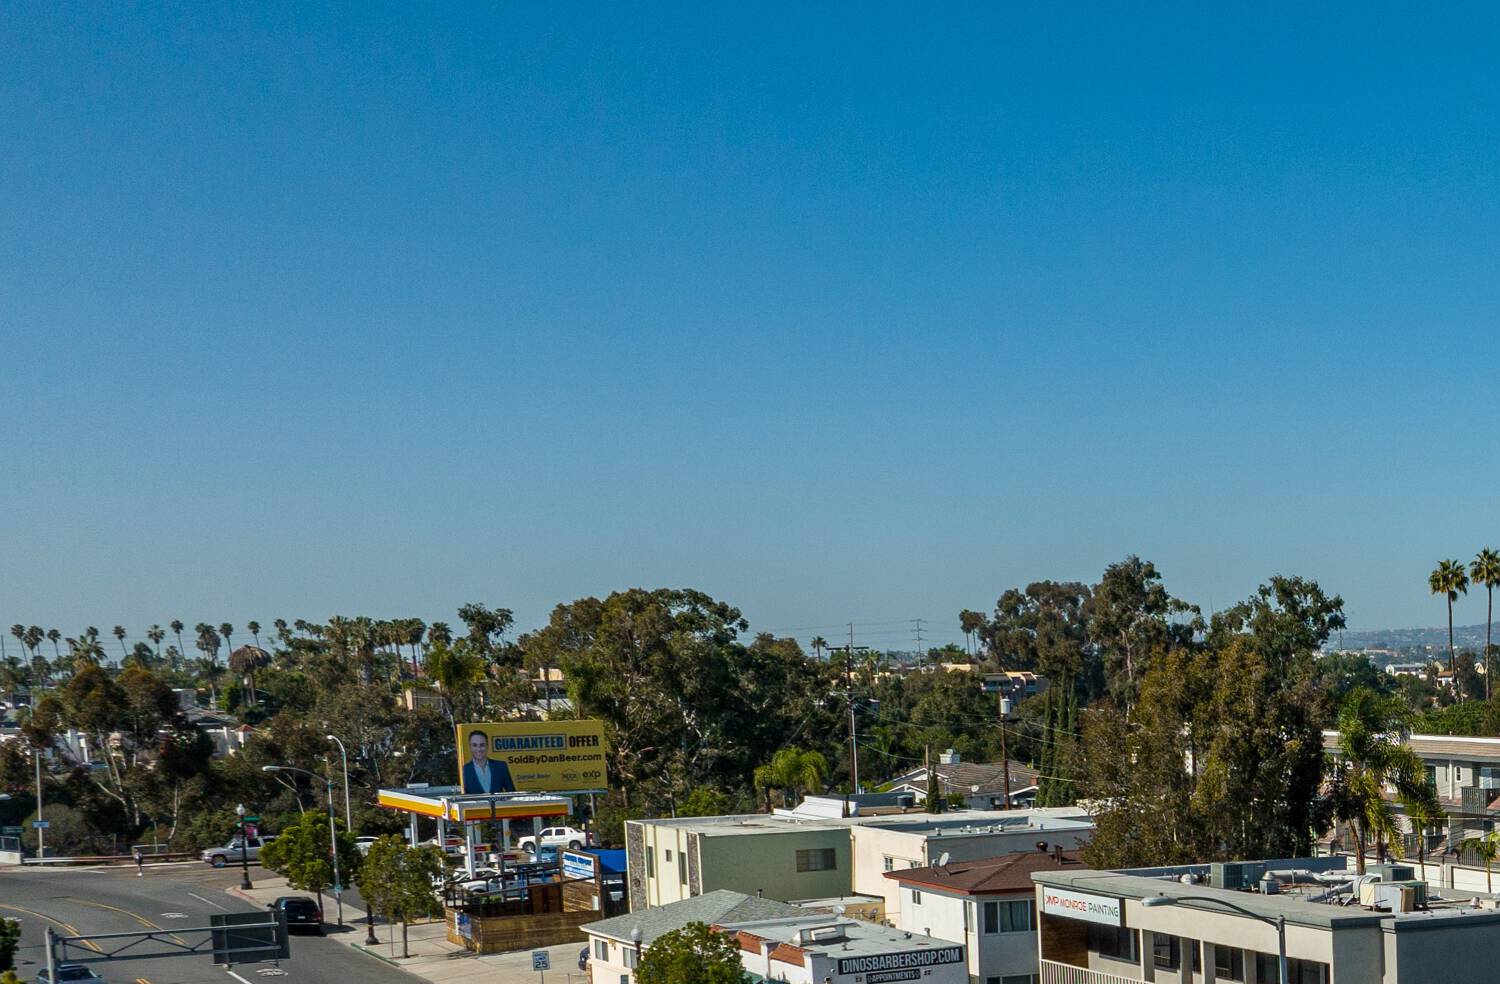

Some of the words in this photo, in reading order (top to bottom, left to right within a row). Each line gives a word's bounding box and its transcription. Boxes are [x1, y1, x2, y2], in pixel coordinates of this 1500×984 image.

[495, 736, 564, 750] GUARANTEED
[569, 735, 599, 747] OFFER
[508, 754, 602, 765] SoldByDanBeer.com
[1060, 898, 1087, 911] MONROE
[1088, 902, 1119, 917] PAINTING
[535, 960, 548, 969] 25
[842, 948, 960, 973] DINOSBARBERSHOP.COM
[872, 972, 915, 983] APPOINTMENTS
